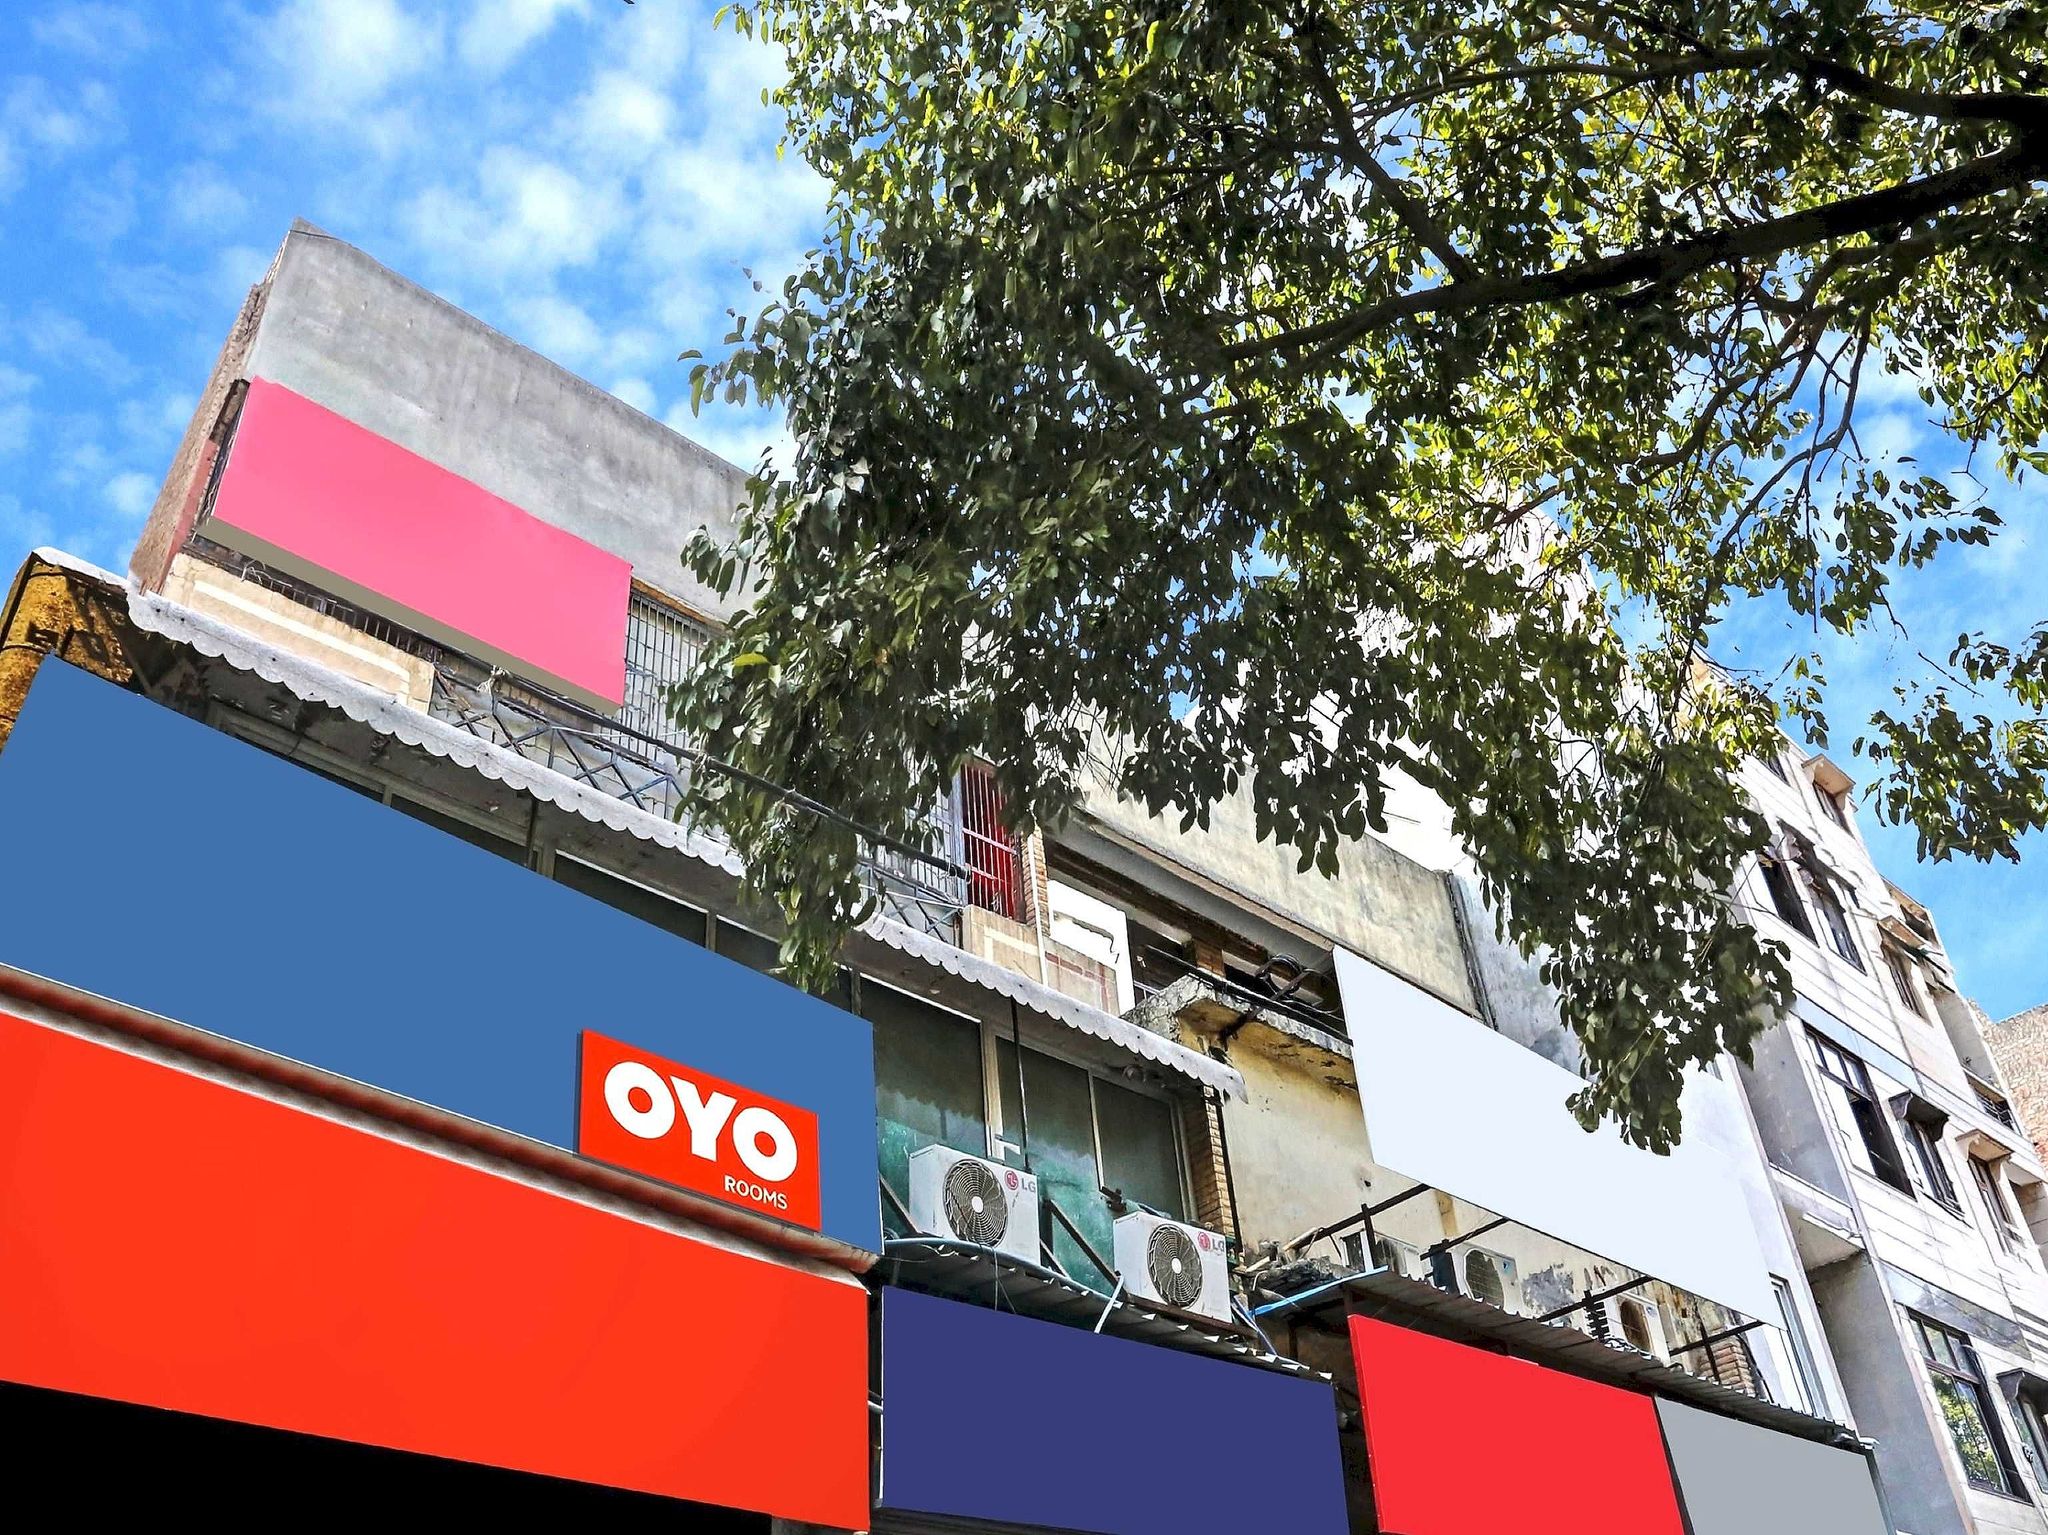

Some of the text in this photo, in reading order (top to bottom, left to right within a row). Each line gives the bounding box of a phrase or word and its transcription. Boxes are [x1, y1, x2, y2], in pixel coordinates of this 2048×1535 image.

[604, 1061, 798, 1182] OYO
[724, 1175, 788, 1210] ROOMS
[1021, 1177, 1036, 1193] LG
